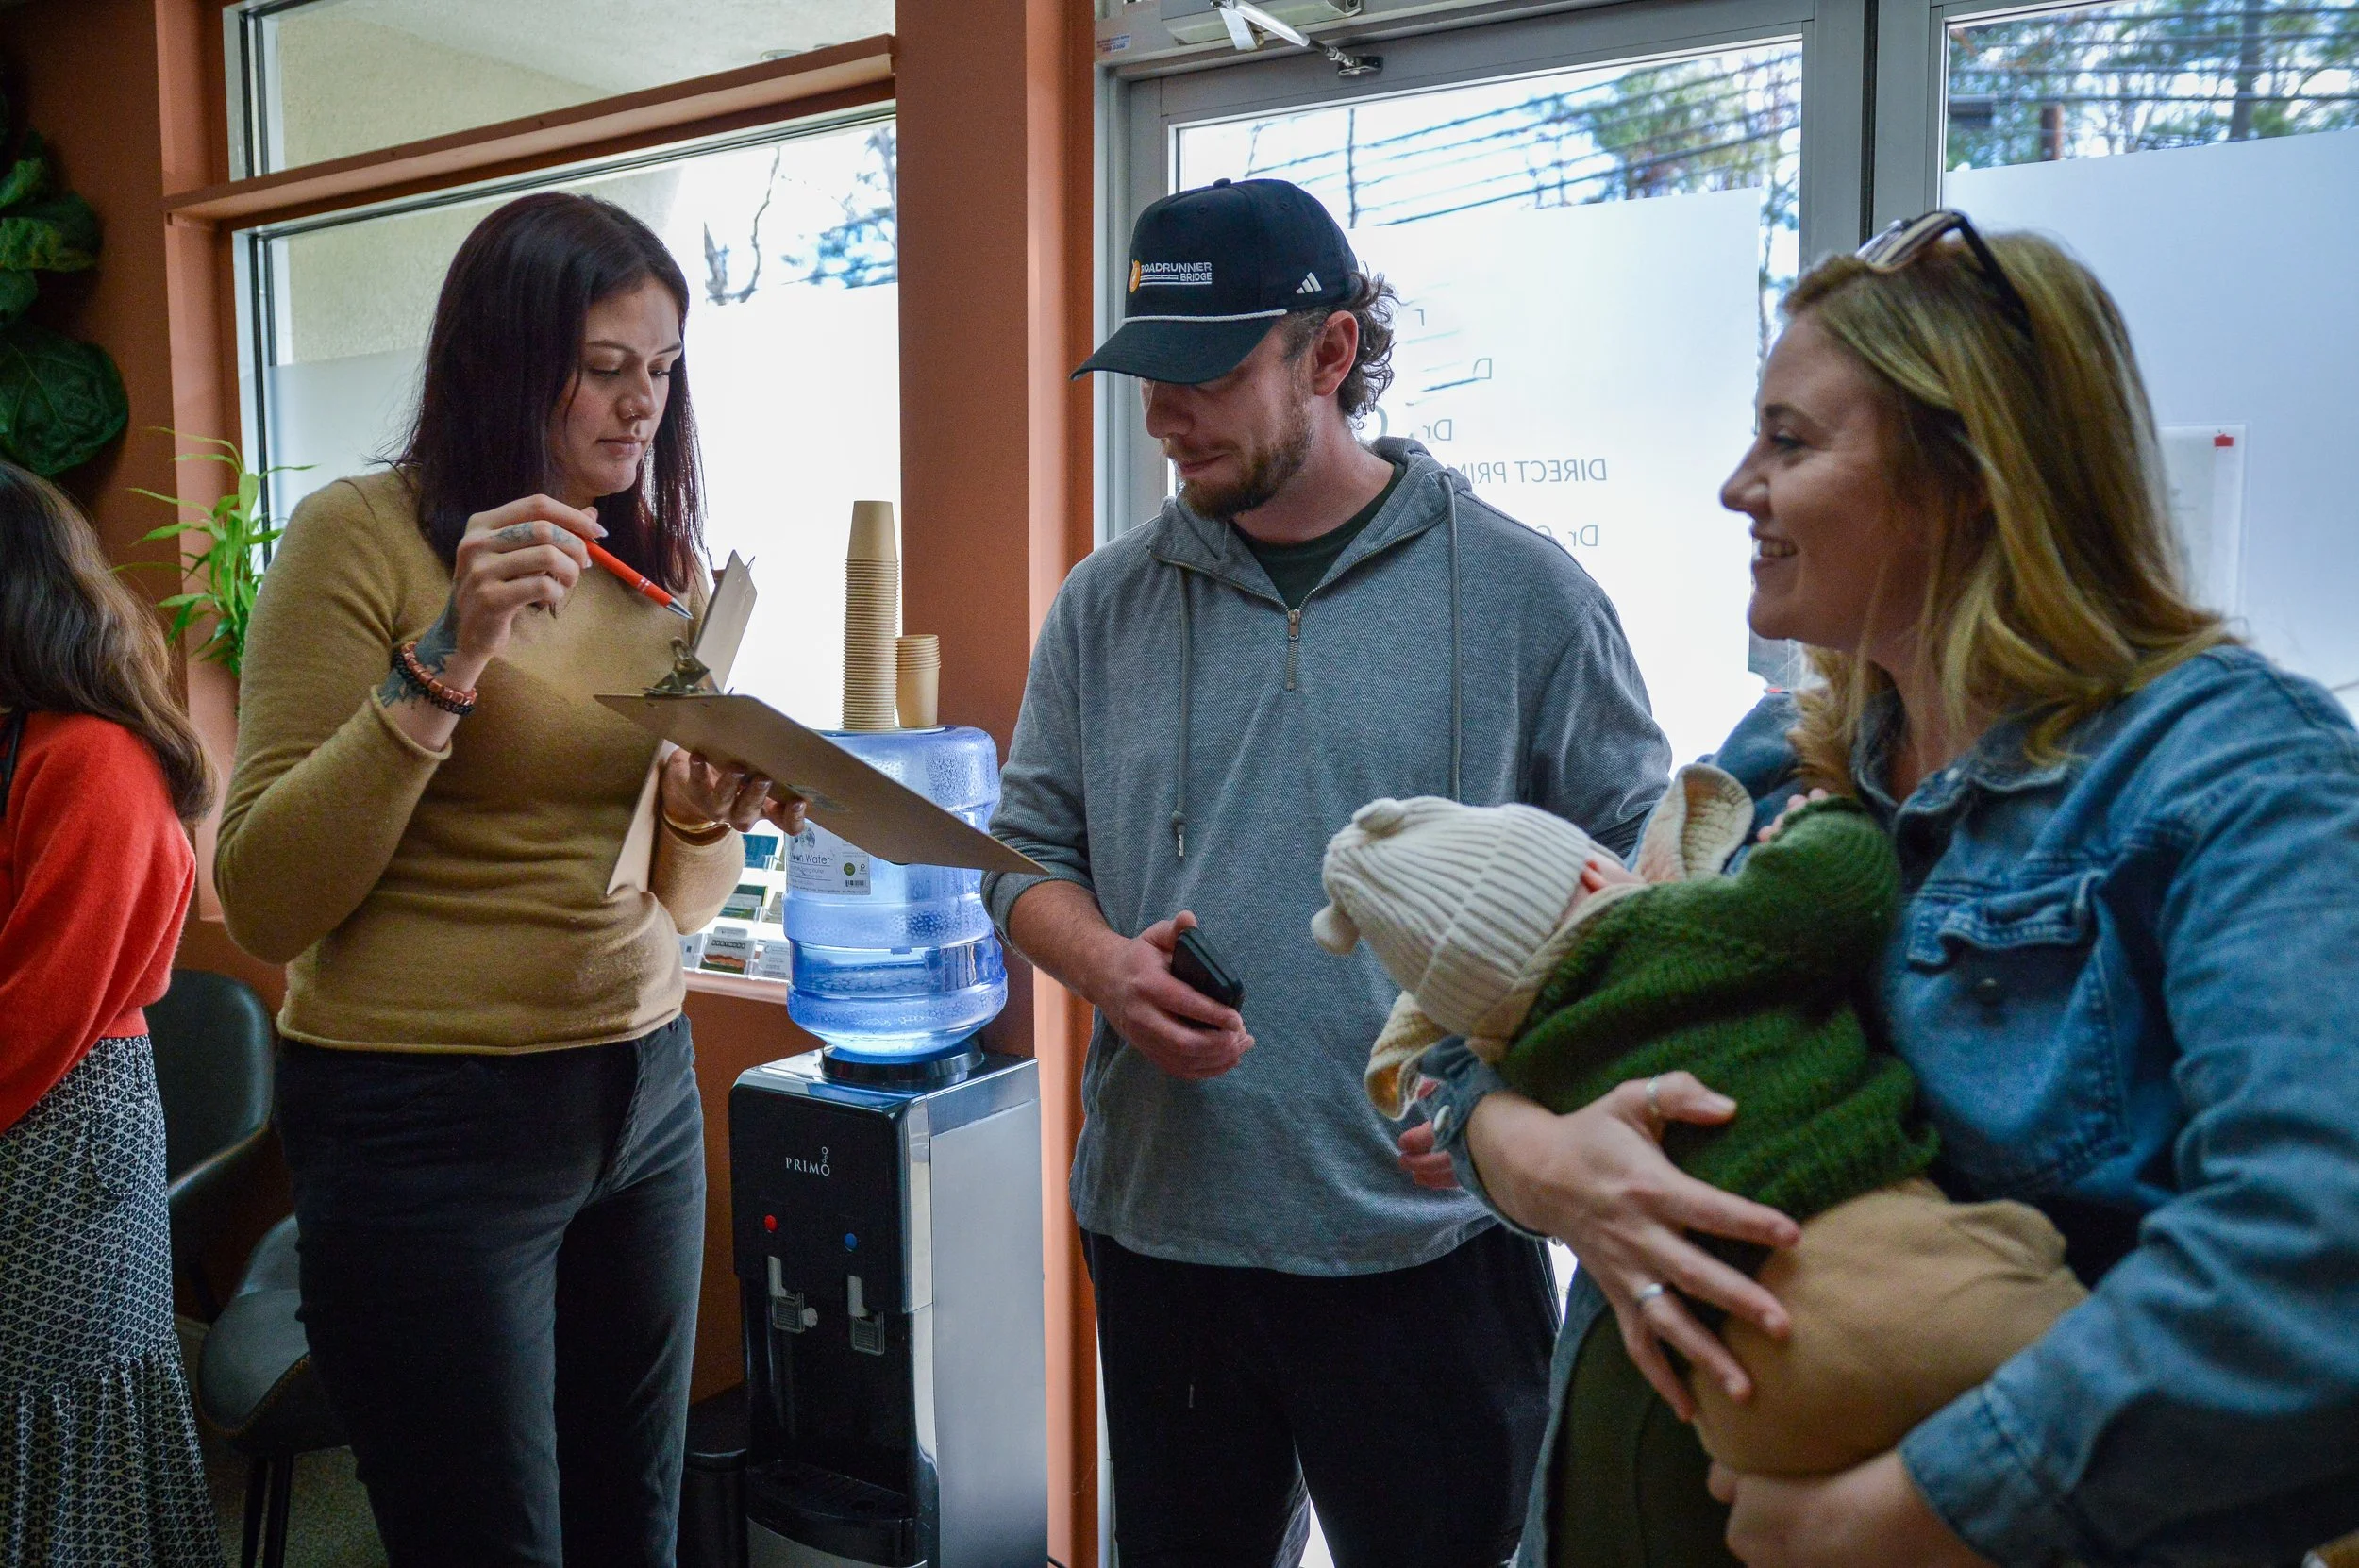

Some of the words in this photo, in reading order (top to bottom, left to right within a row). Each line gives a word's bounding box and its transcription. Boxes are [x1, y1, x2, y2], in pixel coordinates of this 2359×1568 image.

[1180, 273, 1213, 281] BRIDGE
[806, 854, 830, 865] Water
[785, 1157, 830, 1176] PRIMO
